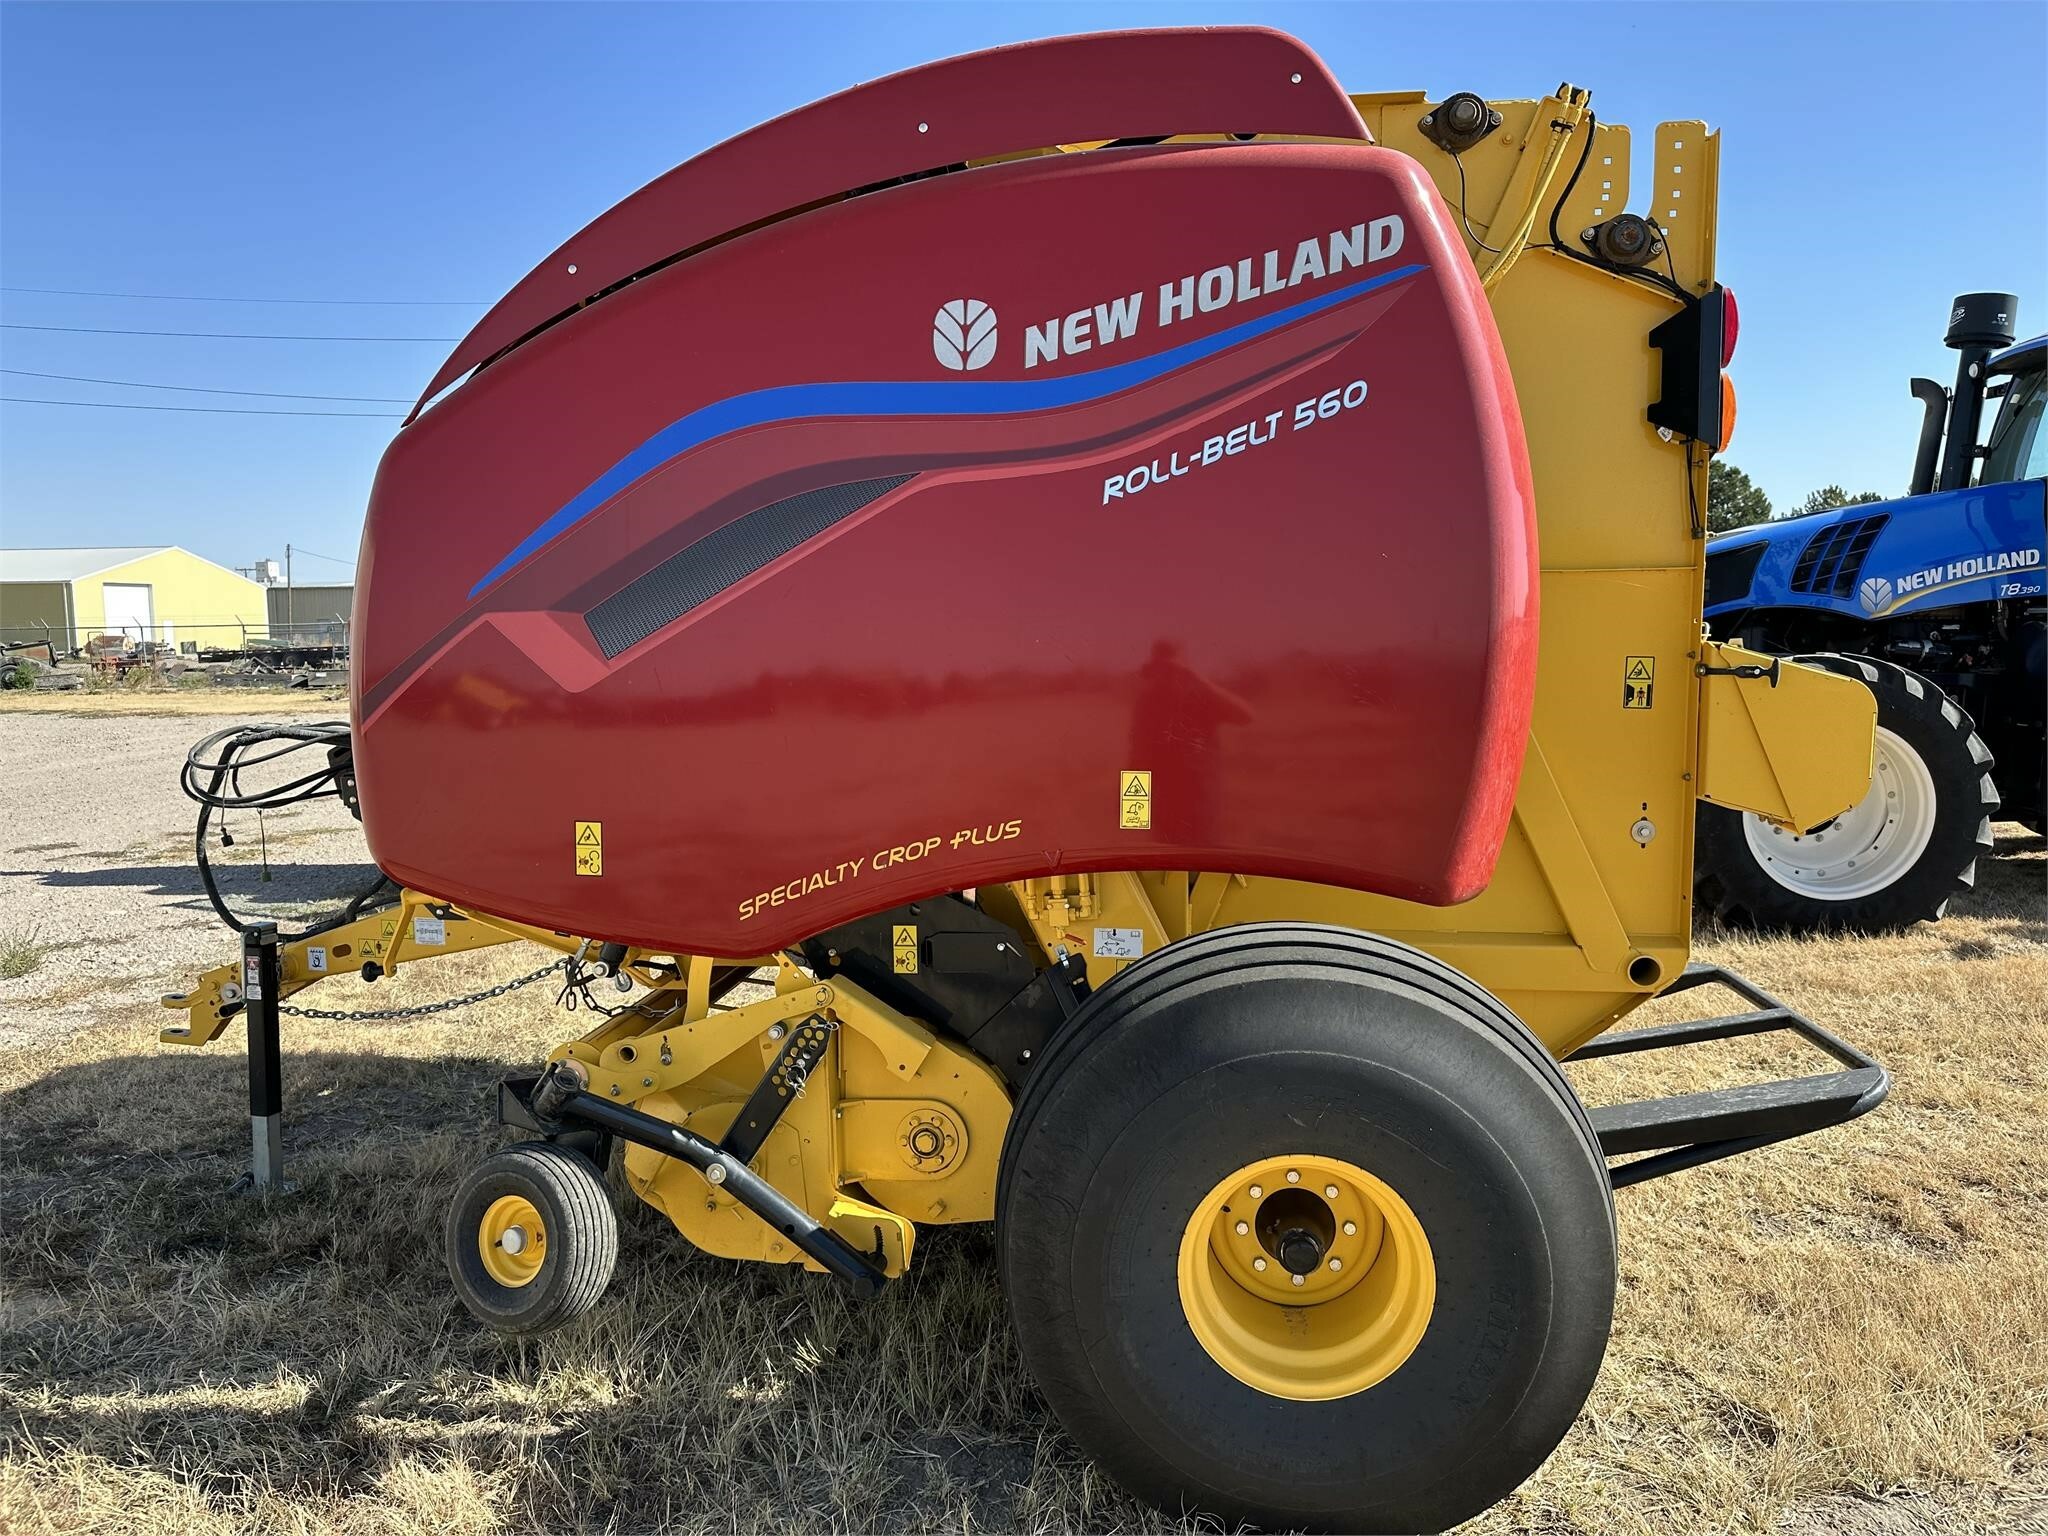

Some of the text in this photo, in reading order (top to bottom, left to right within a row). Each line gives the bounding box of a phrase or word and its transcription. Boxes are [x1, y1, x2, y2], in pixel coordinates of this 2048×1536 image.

[1024, 214, 1405, 369] NEW HOLLAND
[1102, 380, 1369, 506] ROLL-BELT 560
[1897, 549, 2040, 594] NEW HOLLAND
[738, 857, 865, 921] SPECIALTY
[872, 836, 942, 871] CROP
